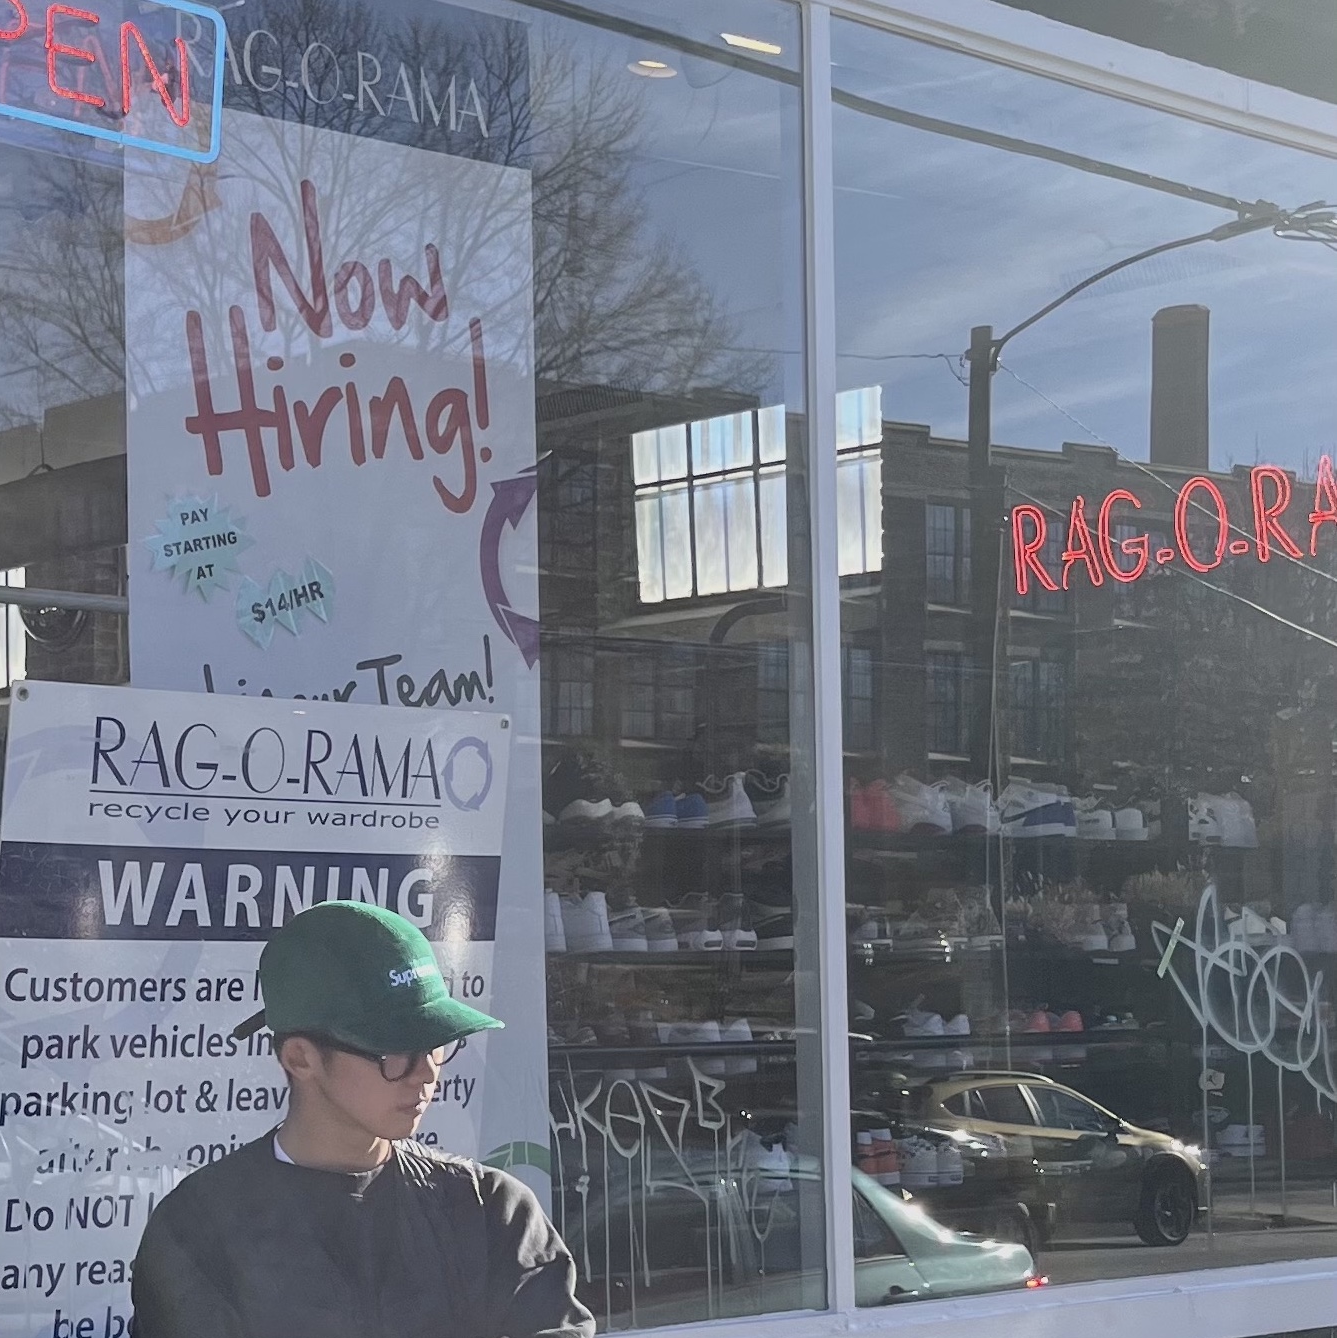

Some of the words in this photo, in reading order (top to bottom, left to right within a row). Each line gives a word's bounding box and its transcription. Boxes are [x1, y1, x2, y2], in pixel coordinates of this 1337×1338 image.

[250, 179, 450, 338] Now
[185, 305, 493, 514] Hiring!
[180, 507, 209, 526] PAY
[163, 531, 238, 557] STARTING
[196, 563, 215, 580] AT
[251, 580, 325, 623] $14/HR
[355, 633, 495, 707] Team!
[90, 715, 442, 800] RAG-O-RAMA
[88, 801, 211, 825] recycle
[224, 807, 297, 827] your
[307, 810, 440, 829] wardrobe
[97, 859, 436, 929] WARNING
[4, 967, 187, 1003] Customers
[195, 976, 245, 1003] are
[462, 970, 485, 999] to
[20, 1024, 101, 1069] park
[110, 1023, 239, 1059] vehicles
[143, 1079, 188, 1115] lot
[194, 1079, 219, 1113] &
[226, 1078, 289, 1112] leav
[4, 1198, 54, 1233] Do
[64, 1194, 135, 1230] NOT
[0, 1262, 66, 1298] any
